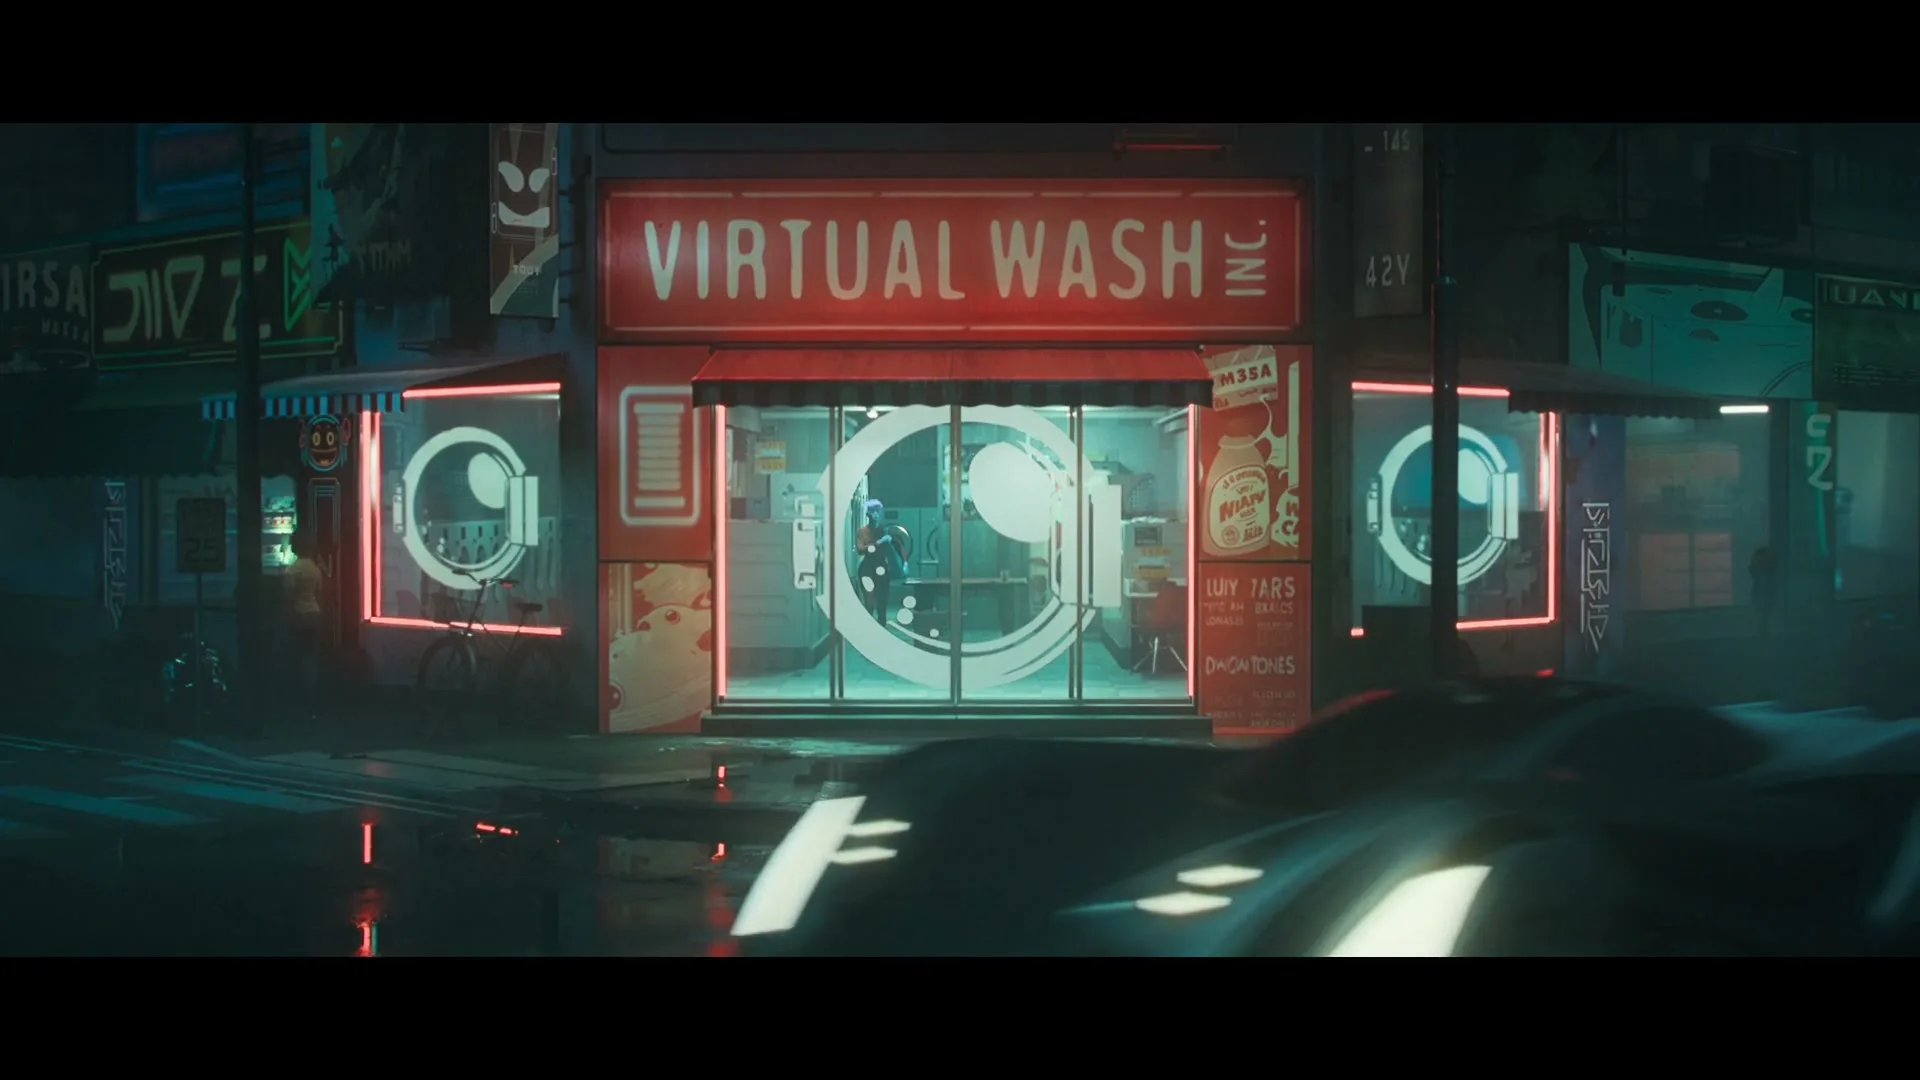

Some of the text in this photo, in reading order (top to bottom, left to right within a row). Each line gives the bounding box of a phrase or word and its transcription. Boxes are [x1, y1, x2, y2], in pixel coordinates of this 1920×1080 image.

[644, 219, 1268, 300] VIRTUAL WASH INC.
[183, 538, 219, 563] 25
